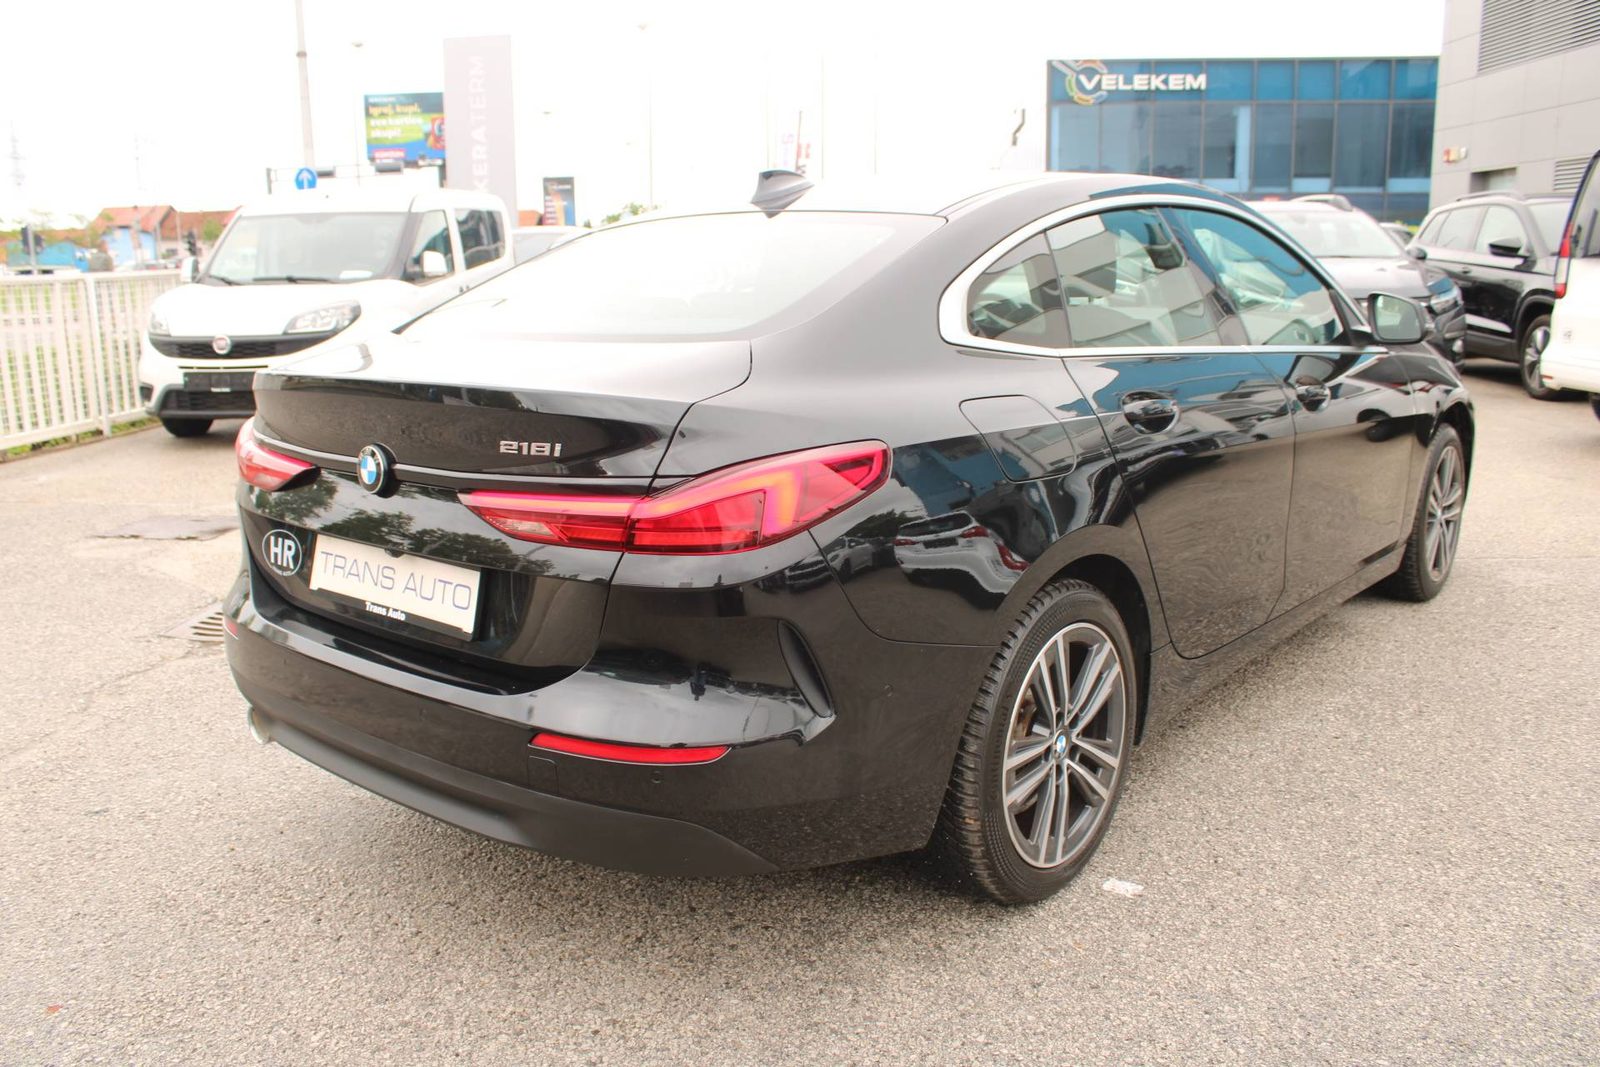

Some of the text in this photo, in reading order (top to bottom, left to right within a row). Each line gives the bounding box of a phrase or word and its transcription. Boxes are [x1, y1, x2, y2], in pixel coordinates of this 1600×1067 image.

[1078, 73, 1207, 91] VELEKEM
[468, 55, 489, 193] KERATERM
[269, 535, 294, 570] HR
[320, 551, 472, 611] TRANS AUTO
[365, 602, 406, 621] Trans Auto
